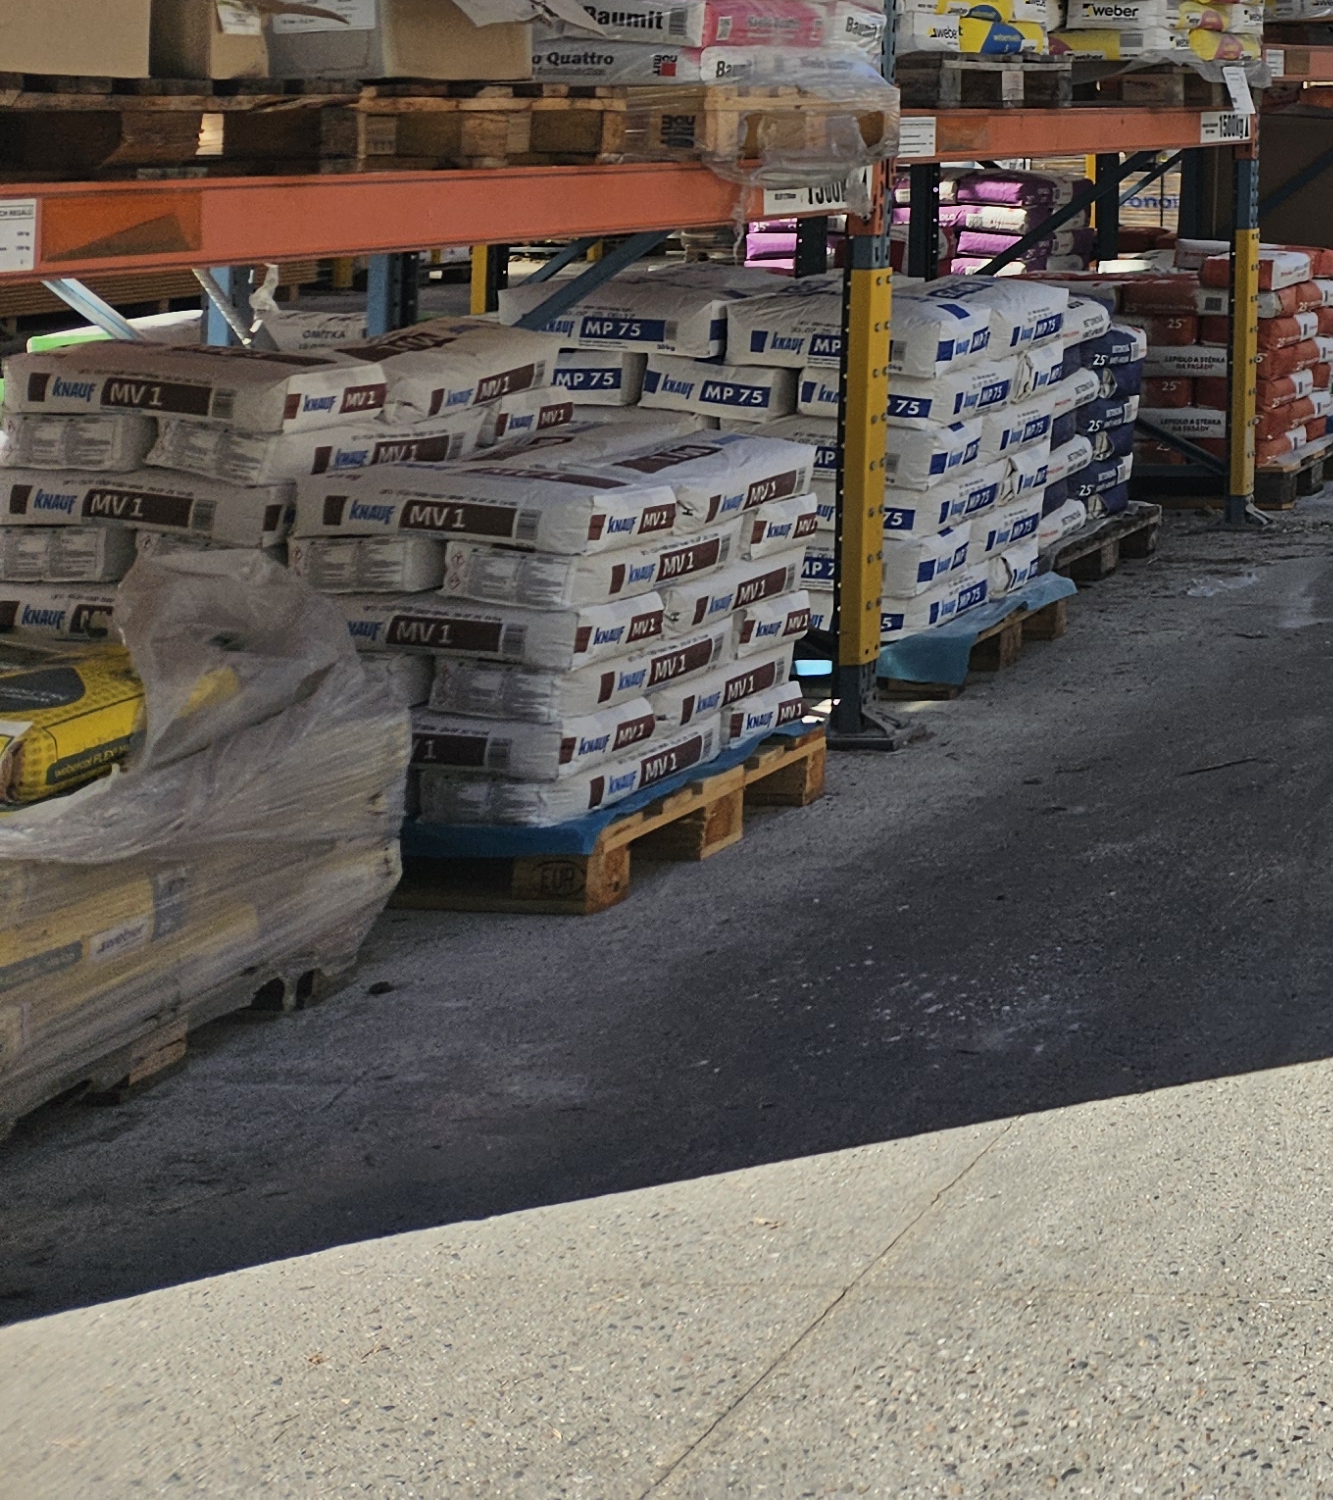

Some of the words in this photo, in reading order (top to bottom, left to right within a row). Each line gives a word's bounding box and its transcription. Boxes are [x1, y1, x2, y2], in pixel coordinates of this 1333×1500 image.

[1093, 4, 1139, 17] weber
[585, 320, 613, 336] MP
[619, 323, 641, 336] 75
[1093, 355, 1107, 365] 25
[557, 373, 584, 386] MP
[590, 371, 615, 385] 75
[52, 376, 96, 399] KNAUF
[661, 374, 695, 399] KNAUF
[705, 385, 734, 400] MP
[738, 388, 763, 404] 75
[896, 400, 920, 415] 75
[1088, 420, 1101, 432] 25
[766, 521, 791, 539] KNAUF
[22, 605, 65, 629] KNAUF
[746, 709, 773, 730] KNAUF
